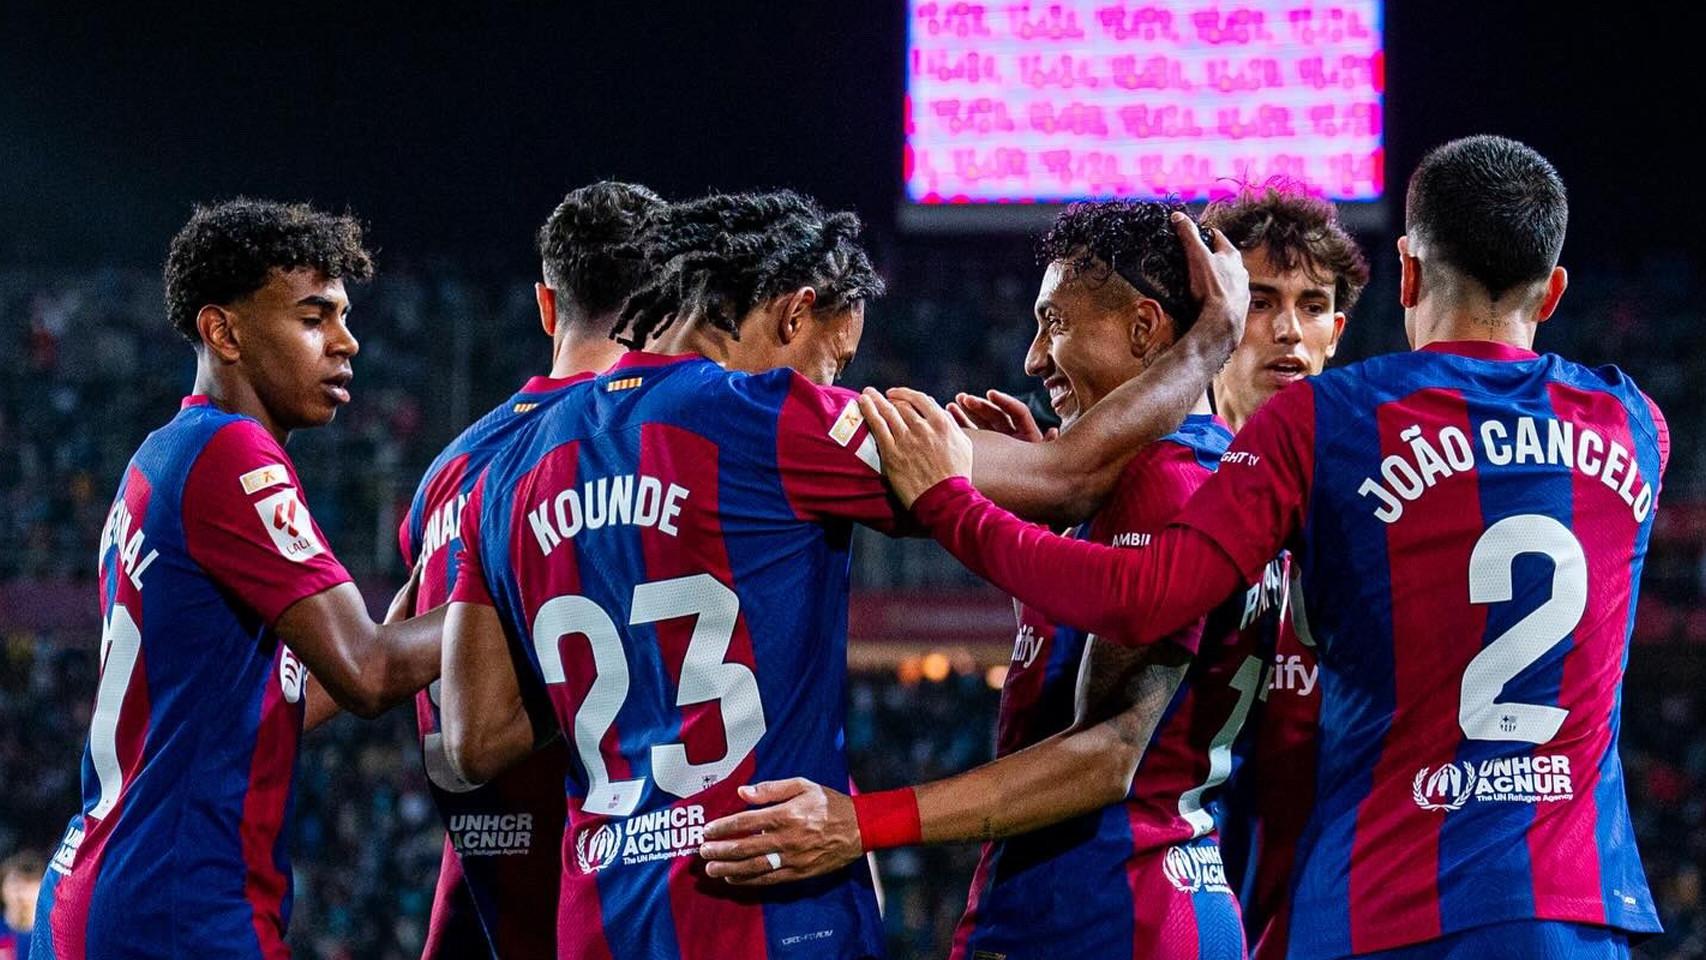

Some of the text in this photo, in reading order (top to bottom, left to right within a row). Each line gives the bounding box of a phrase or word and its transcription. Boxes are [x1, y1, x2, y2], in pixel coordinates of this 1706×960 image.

[1358, 417, 1652, 523] JOÃO CANCELO
[528, 475, 690, 556] KOUNDE
[1459, 514, 1588, 744] 2
[533, 574, 767, 816] 23
[1479, 755, 1571, 777] UNHCR
[1475, 774, 1573, 794] ACNUR
[1477, 794, 1492, 802] The
[1509, 794, 1541, 803] Refugee
[1543, 793, 1574, 803] Agency
[449, 813, 533, 832] UNHCR
[625, 805, 705, 836] UNHCR
[623, 826, 705, 857] ACNUR
